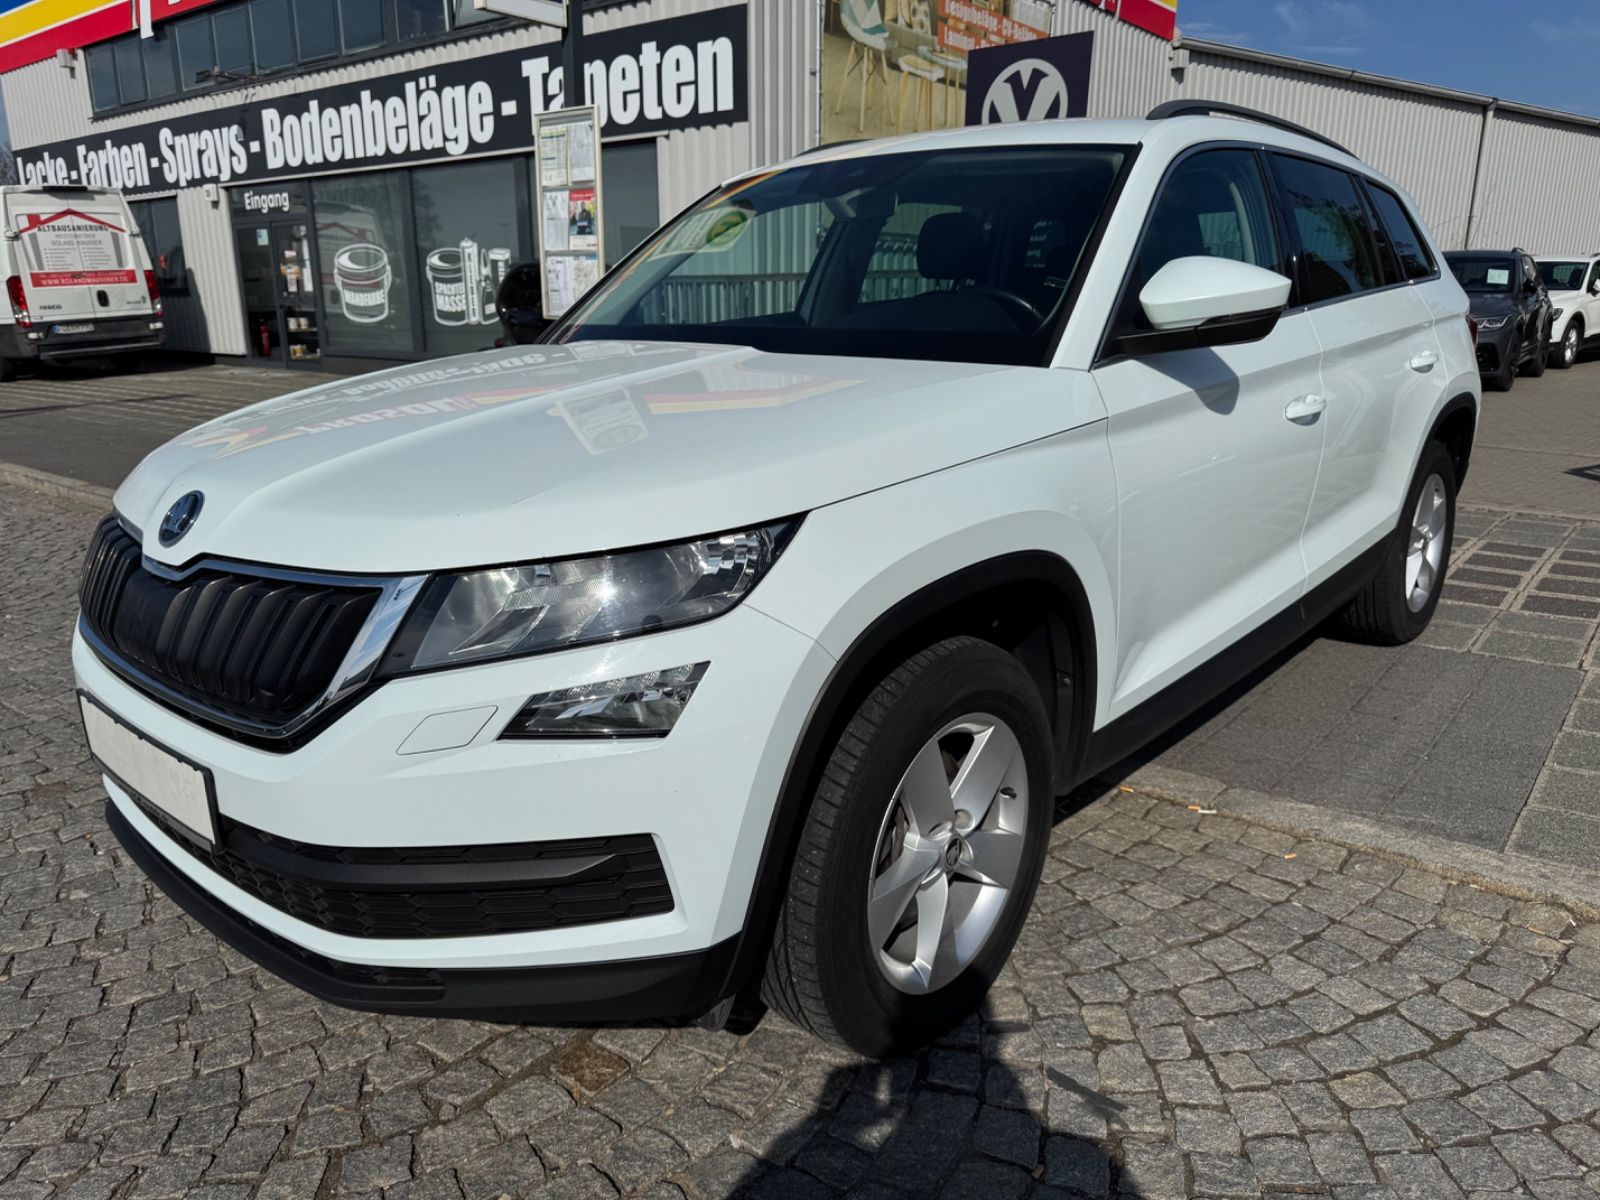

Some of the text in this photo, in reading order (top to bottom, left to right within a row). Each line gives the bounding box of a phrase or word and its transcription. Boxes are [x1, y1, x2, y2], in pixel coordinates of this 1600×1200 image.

[76, 139, 150, 189] Farben
[159, 124, 248, 187] Sprays
[261, 75, 495, 169] Bodenbeläge
[244, 190, 290, 213] Eingang
[37, 224, 108, 233] ALTBAUSANIERUNG
